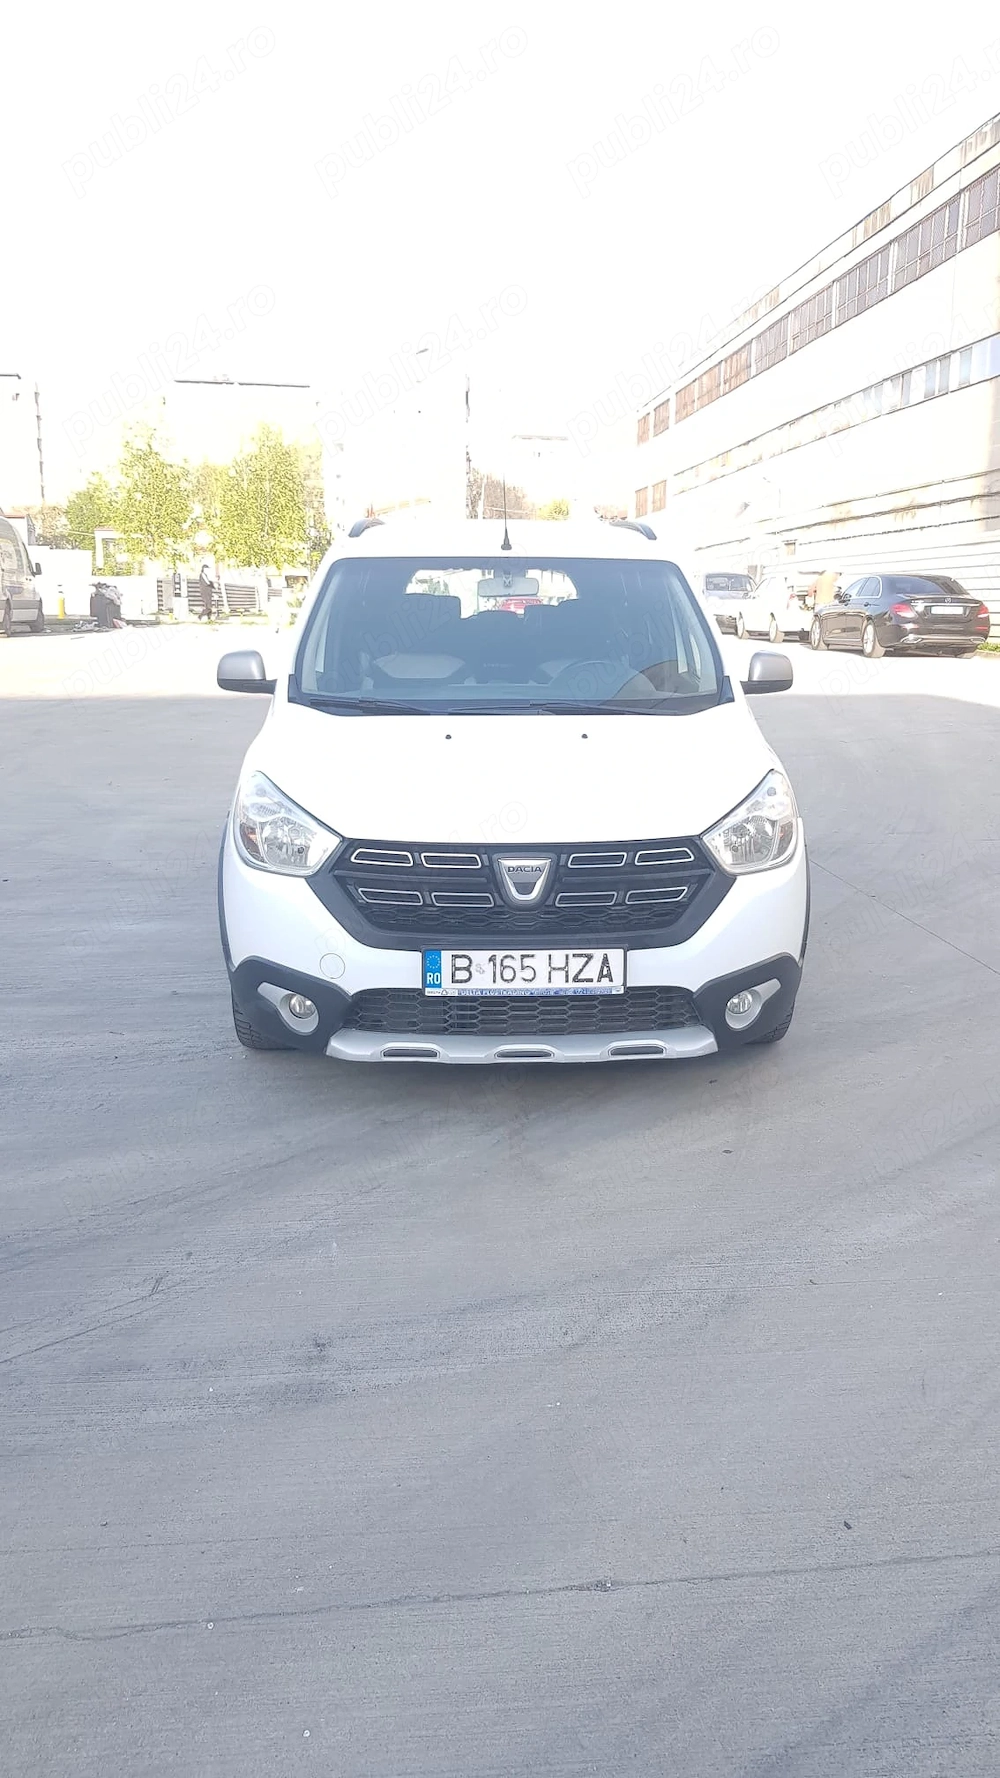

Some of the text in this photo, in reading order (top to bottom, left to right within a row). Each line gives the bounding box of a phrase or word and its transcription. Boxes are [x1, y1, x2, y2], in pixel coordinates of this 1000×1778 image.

[427, 972, 440, 984] RO
[451, 953, 613, 983] B 165 HZA
